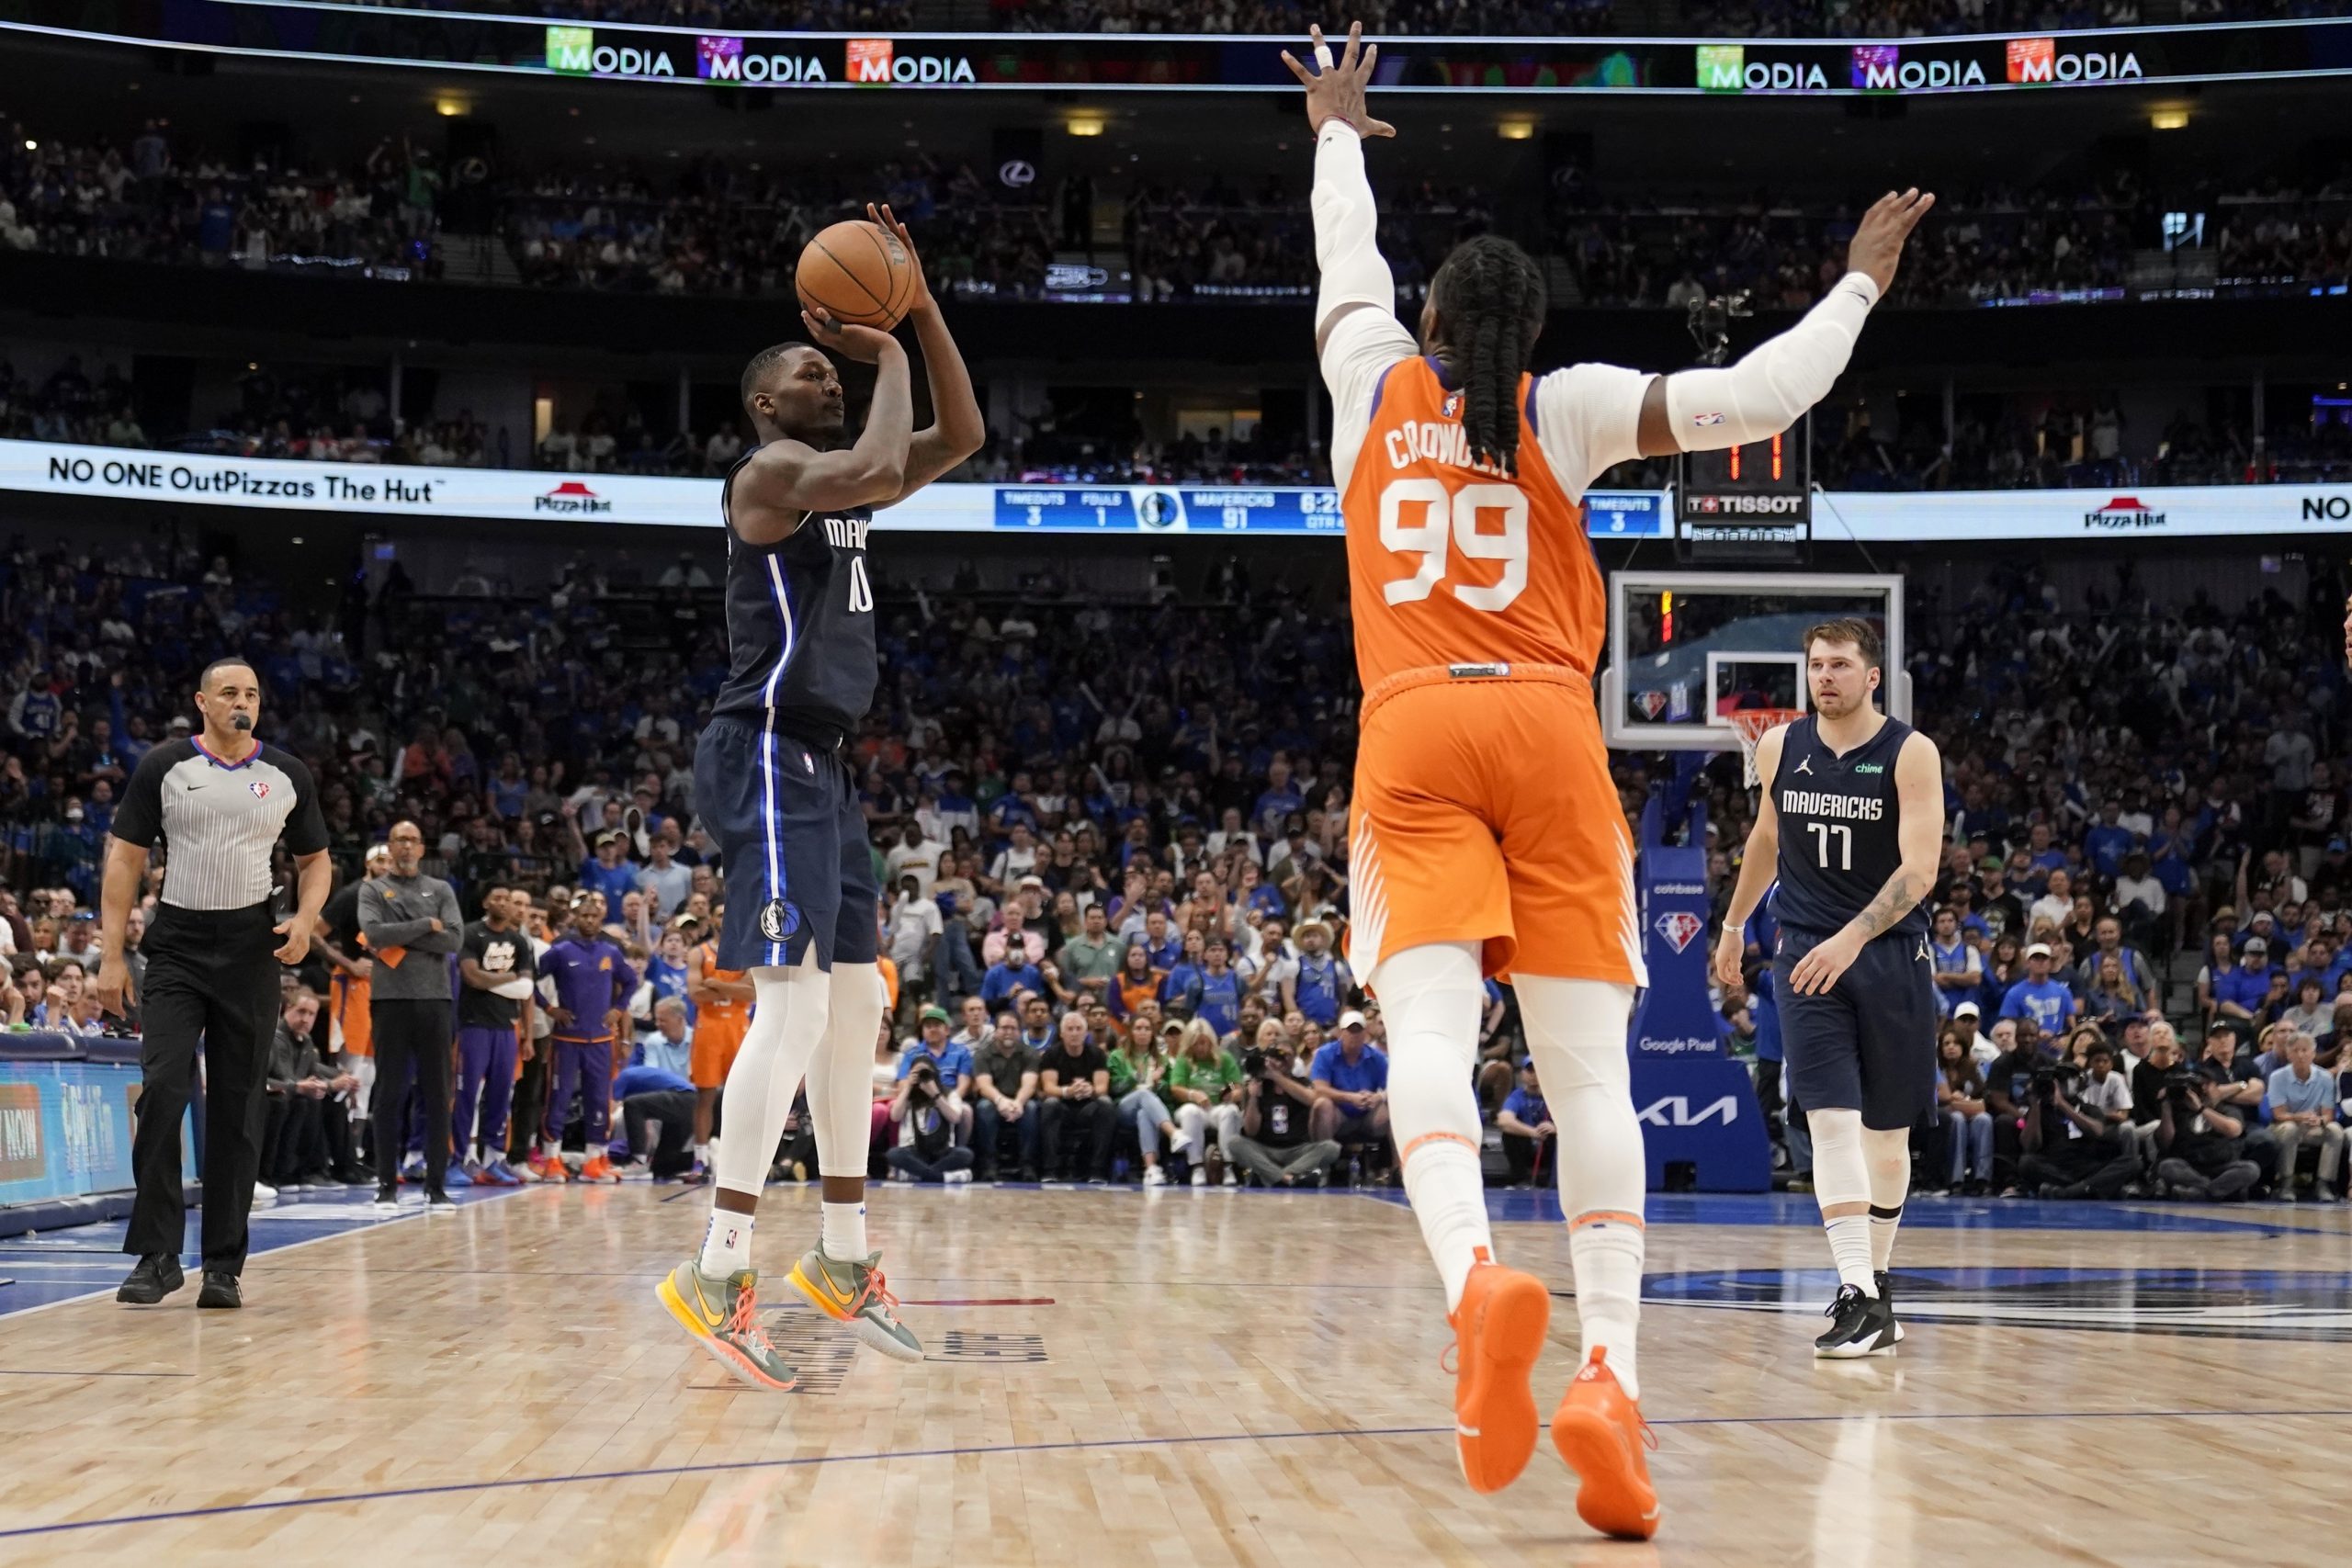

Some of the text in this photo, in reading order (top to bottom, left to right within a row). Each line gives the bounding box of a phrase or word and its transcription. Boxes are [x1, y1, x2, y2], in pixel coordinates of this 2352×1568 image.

[560, 46, 674, 75] MODIA
[710, 52, 827, 82] MODIA
[859, 55, 976, 83] MODIA
[2021, 52, 2143, 83] MODIA
[1711, 62, 1828, 90] MODIA
[1865, 60, 1985, 89] MODIA
[49, 457, 94, 481] NO
[103, 461, 163, 487] ONE
[170, 467, 315, 498] OutPizzas
[324, 476, 377, 501] The
[535, 496, 579, 513] Pizza
[1193, 492, 1275, 507] MAVERICKS
[1589, 497, 1652, 512] TIMEOUTS
[1720, 496, 1803, 513] TISSOT
[2302, 497, 2350, 520] NO
[1026, 507, 1248, 528] 3 1 91
[1611, 513, 1625, 532] 3
[2085, 512, 2166, 528] Pizza Hut
[1380, 479, 1529, 612] 99
[1855, 763, 1883, 774] chime
[1782, 790, 1883, 820] MAVERICKS
[1807, 822, 1852, 870] 77
[1654, 884, 1704, 896] coinbase
[1640, 1037, 1716, 1054] Google Pixel
